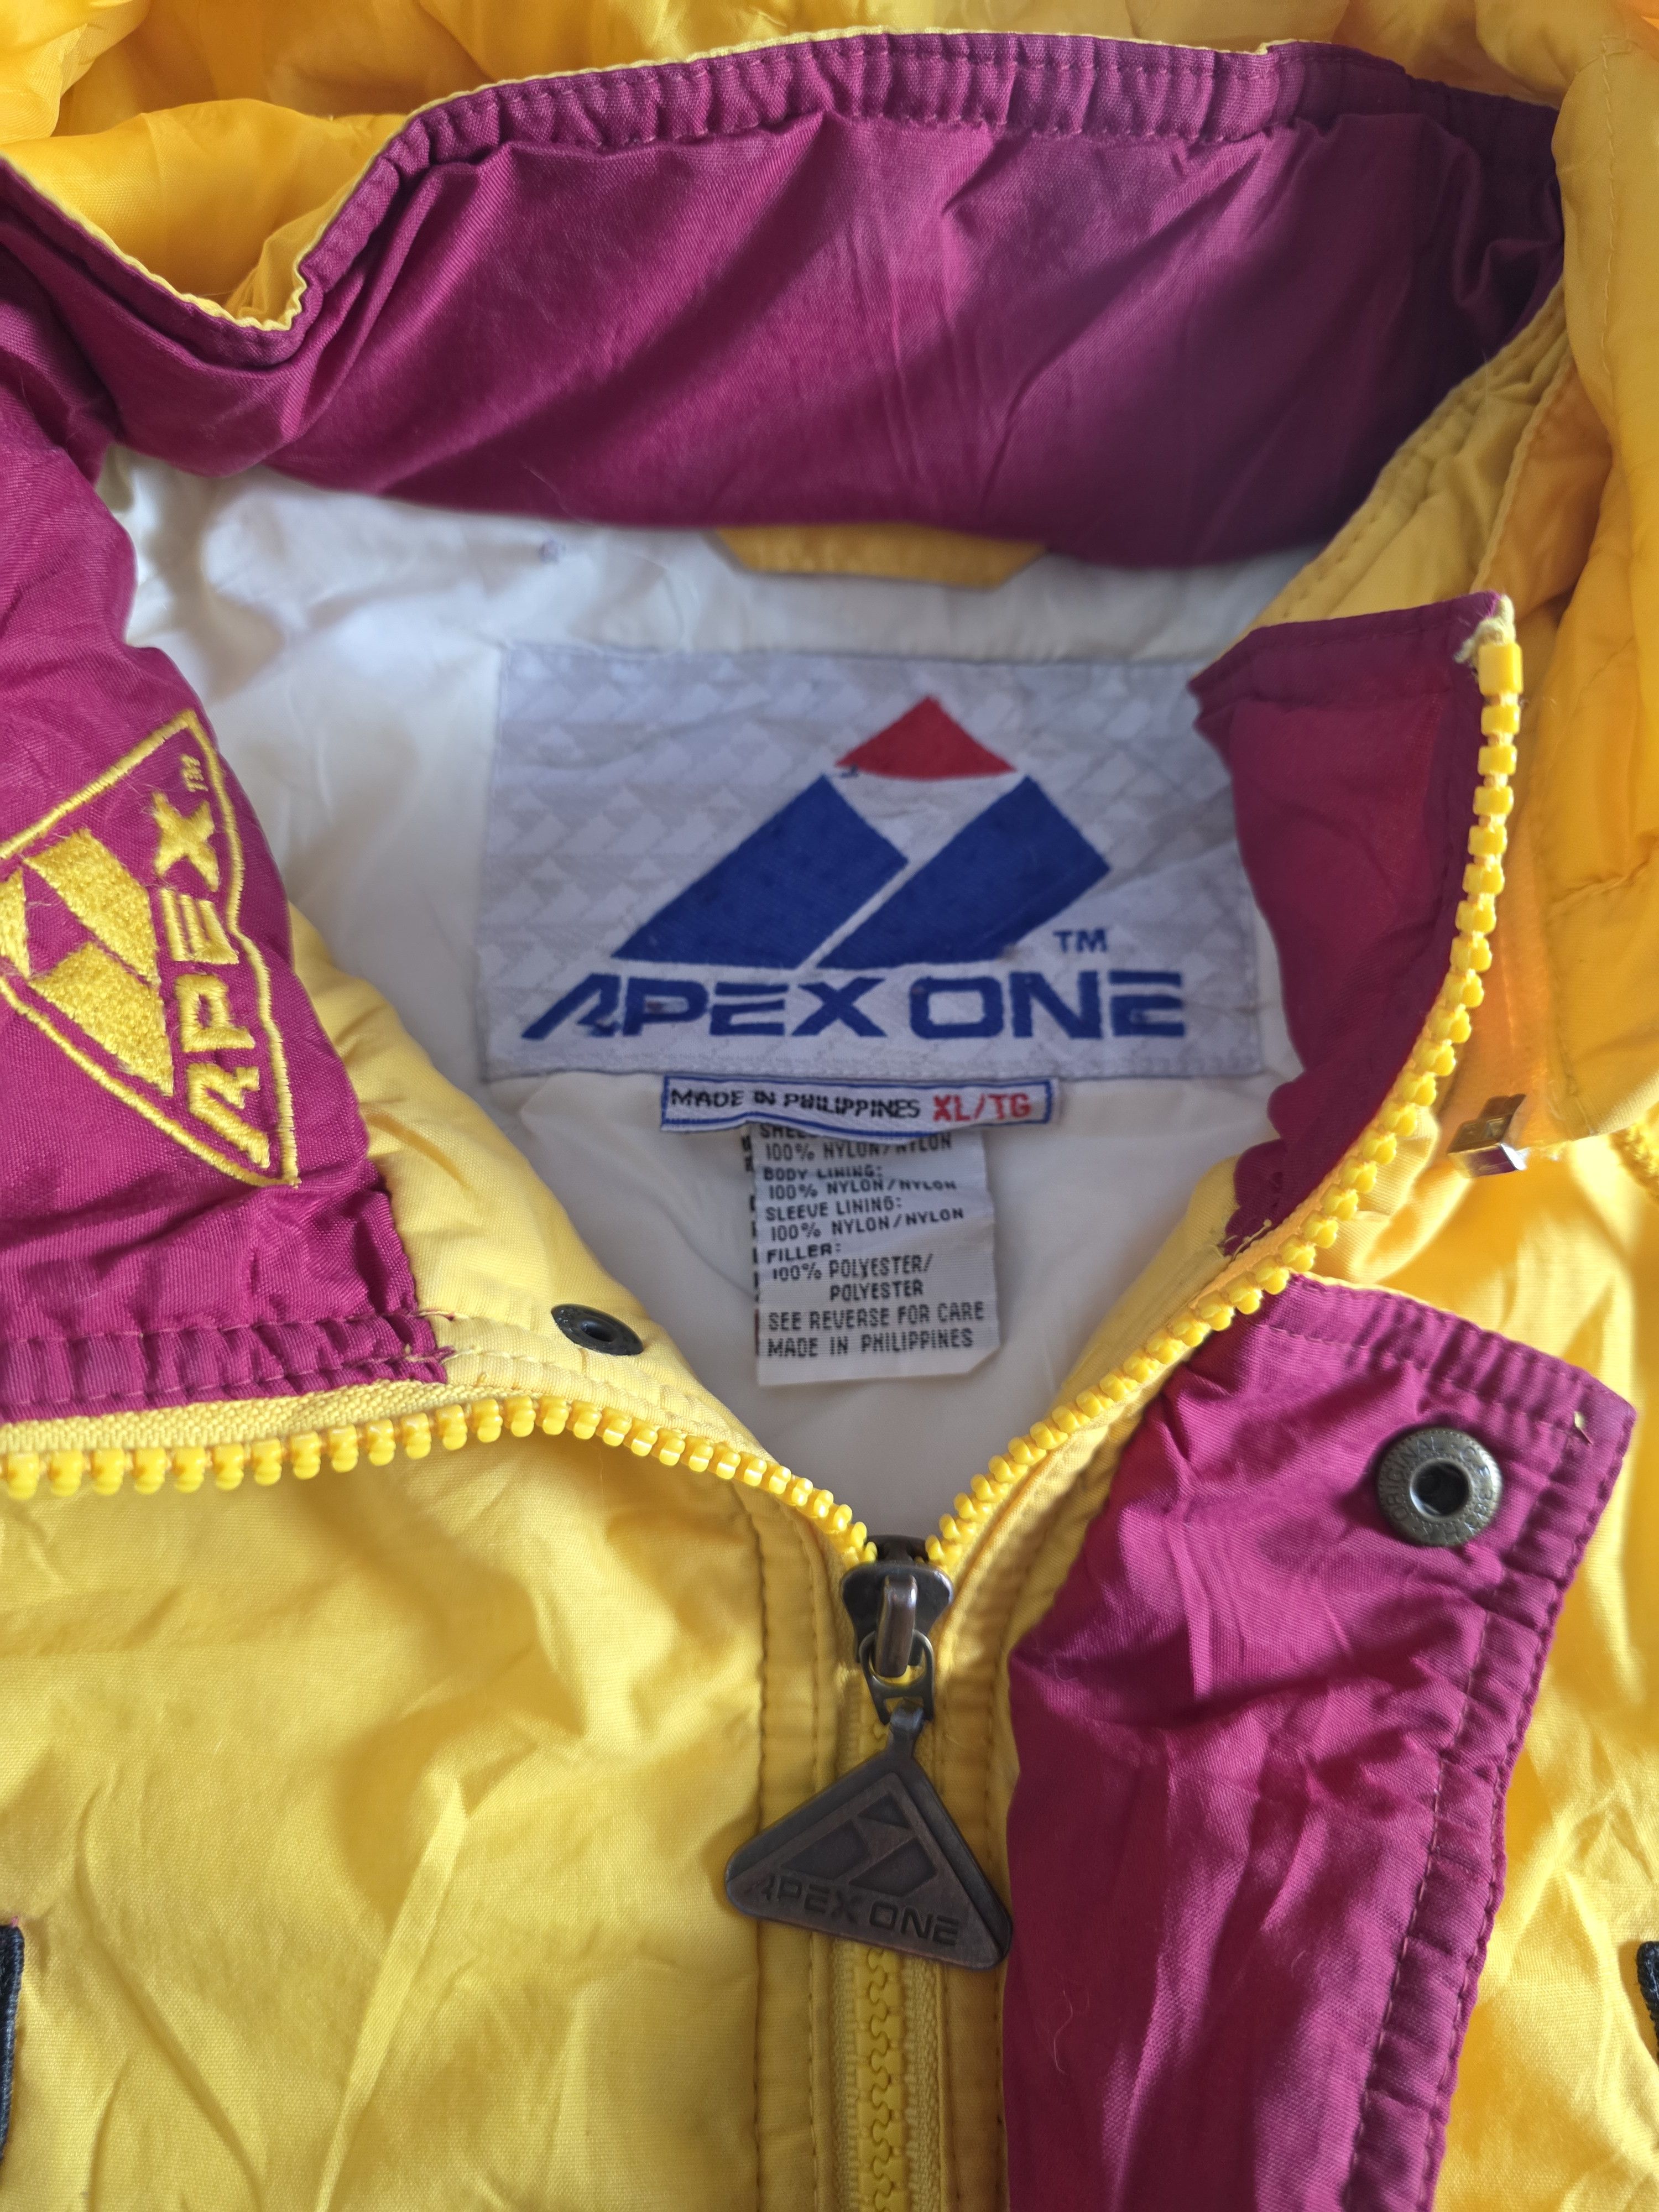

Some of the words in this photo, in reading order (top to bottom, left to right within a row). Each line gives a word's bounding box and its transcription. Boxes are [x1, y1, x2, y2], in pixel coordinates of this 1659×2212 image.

[1054, 930, 1106, 953] TM
[154, 791, 271, 1169] APEX
[521, 972, 888, 1040] APEX
[909, 970, 1185, 1040] ONE
[671, 1088, 744, 1108] MADE
[753, 1090, 776, 1105] IN
[784, 1093, 920, 1119] PHILIPPINES
[933, 1093, 1032, 1122] XL/TG
[760, 1124, 817, 1138] SHE
[766, 1142, 815, 1161] 100%
[763, 1166, 808, 1181] BODY
[817, 1165, 884, 1180] LINING:
[769, 1182, 818, 1201] 100%
[827, 1178, 957, 1195] NYLON/NYLON
[766, 1201, 828, 1222] SLEEVE
[836, 1196, 902, 1216] LINING:
[771, 1222, 821, 1241] 100%
[831, 1207, 964, 1235] NYLON/NYLON
[766, 1243, 841, 1264] FILLER:
[772, 1262, 822, 1282] 100%
[829, 1253, 933, 1279] POLYESTER/
[830, 1279, 924, 1302] POLYESTER
[768, 1311, 802, 1331] SEE
[808, 1306, 890, 1329] REVERSE
[897, 1303, 931, 1326] FOR
[936, 1300, 985, 1322] CARE
[766, 1337, 818, 1357] MADE
[830, 1335, 849, 1355] IN
[860, 1327, 974, 1353] PHILIPPINES
[743, 1874, 862, 1924] APEX
[869, 1900, 959, 1948] ONE
